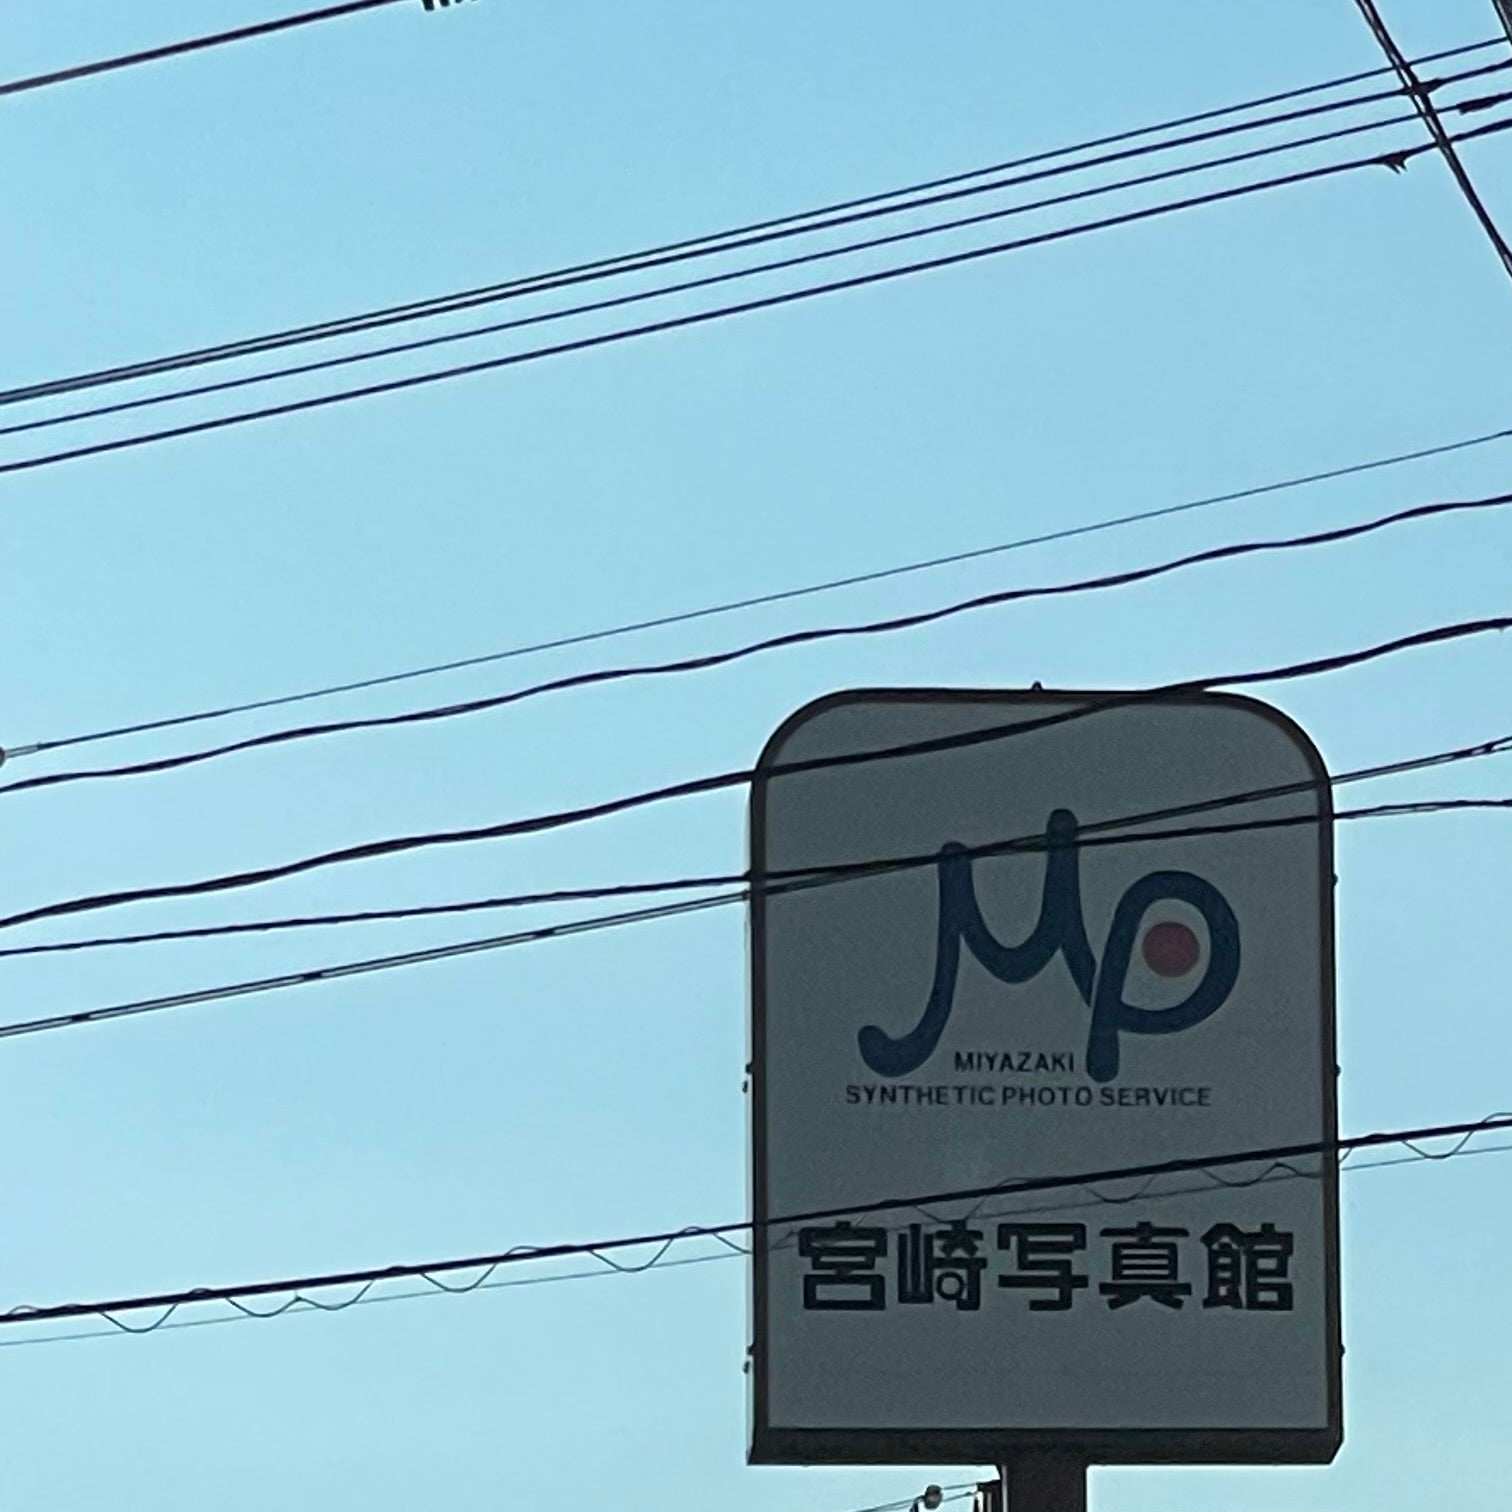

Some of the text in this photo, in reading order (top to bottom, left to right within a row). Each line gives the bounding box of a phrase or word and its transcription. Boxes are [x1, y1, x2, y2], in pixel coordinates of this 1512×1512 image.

[954, 1051, 1075, 1074] MIYAZAKI
[845, 1084, 1212, 1108] SYNTHETIC PHOTO SERVICE
[799, 1220, 1295, 1312] 宮崎写真館
